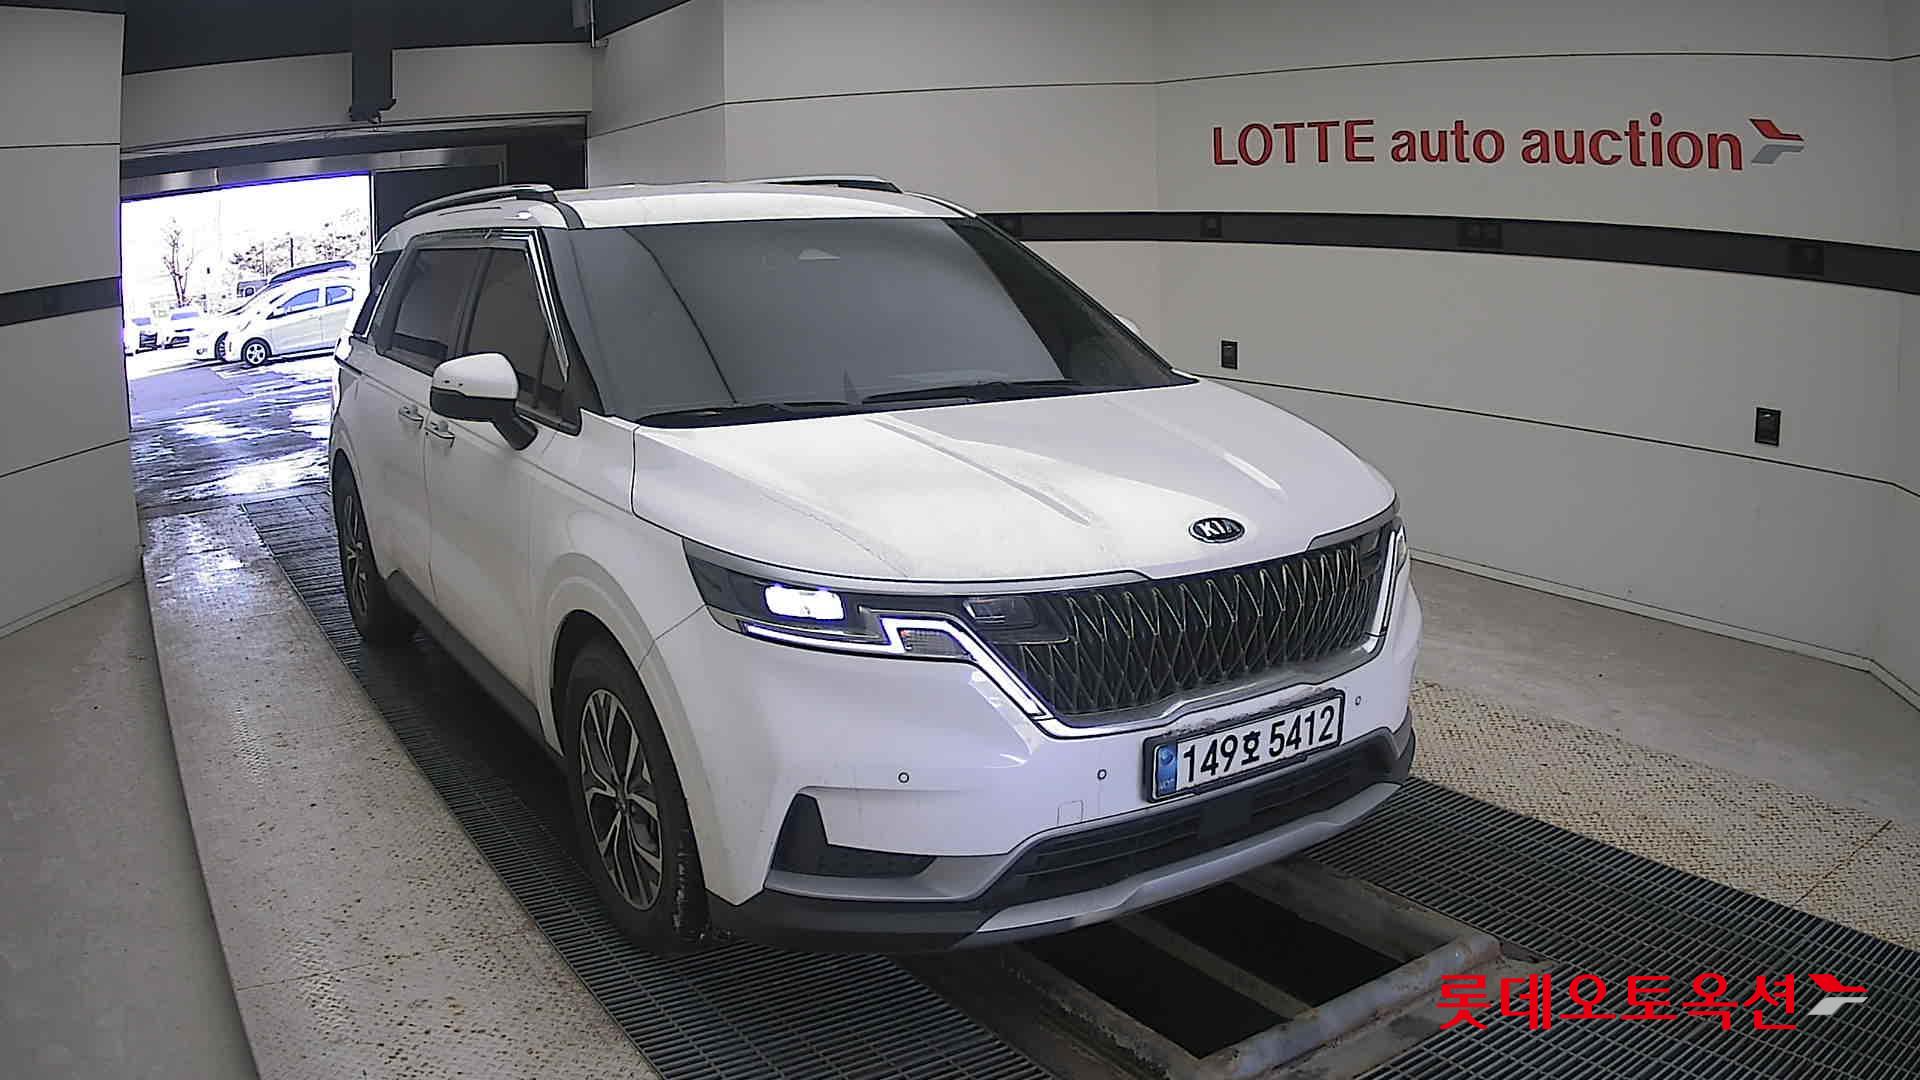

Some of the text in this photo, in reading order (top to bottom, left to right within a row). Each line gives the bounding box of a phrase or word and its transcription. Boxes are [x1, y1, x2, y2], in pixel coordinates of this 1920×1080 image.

[1213, 112, 1744, 171] LOTTE auto auction
[1195, 519, 1241, 537] KIA
[1183, 705, 1335, 783] 149호 5412
